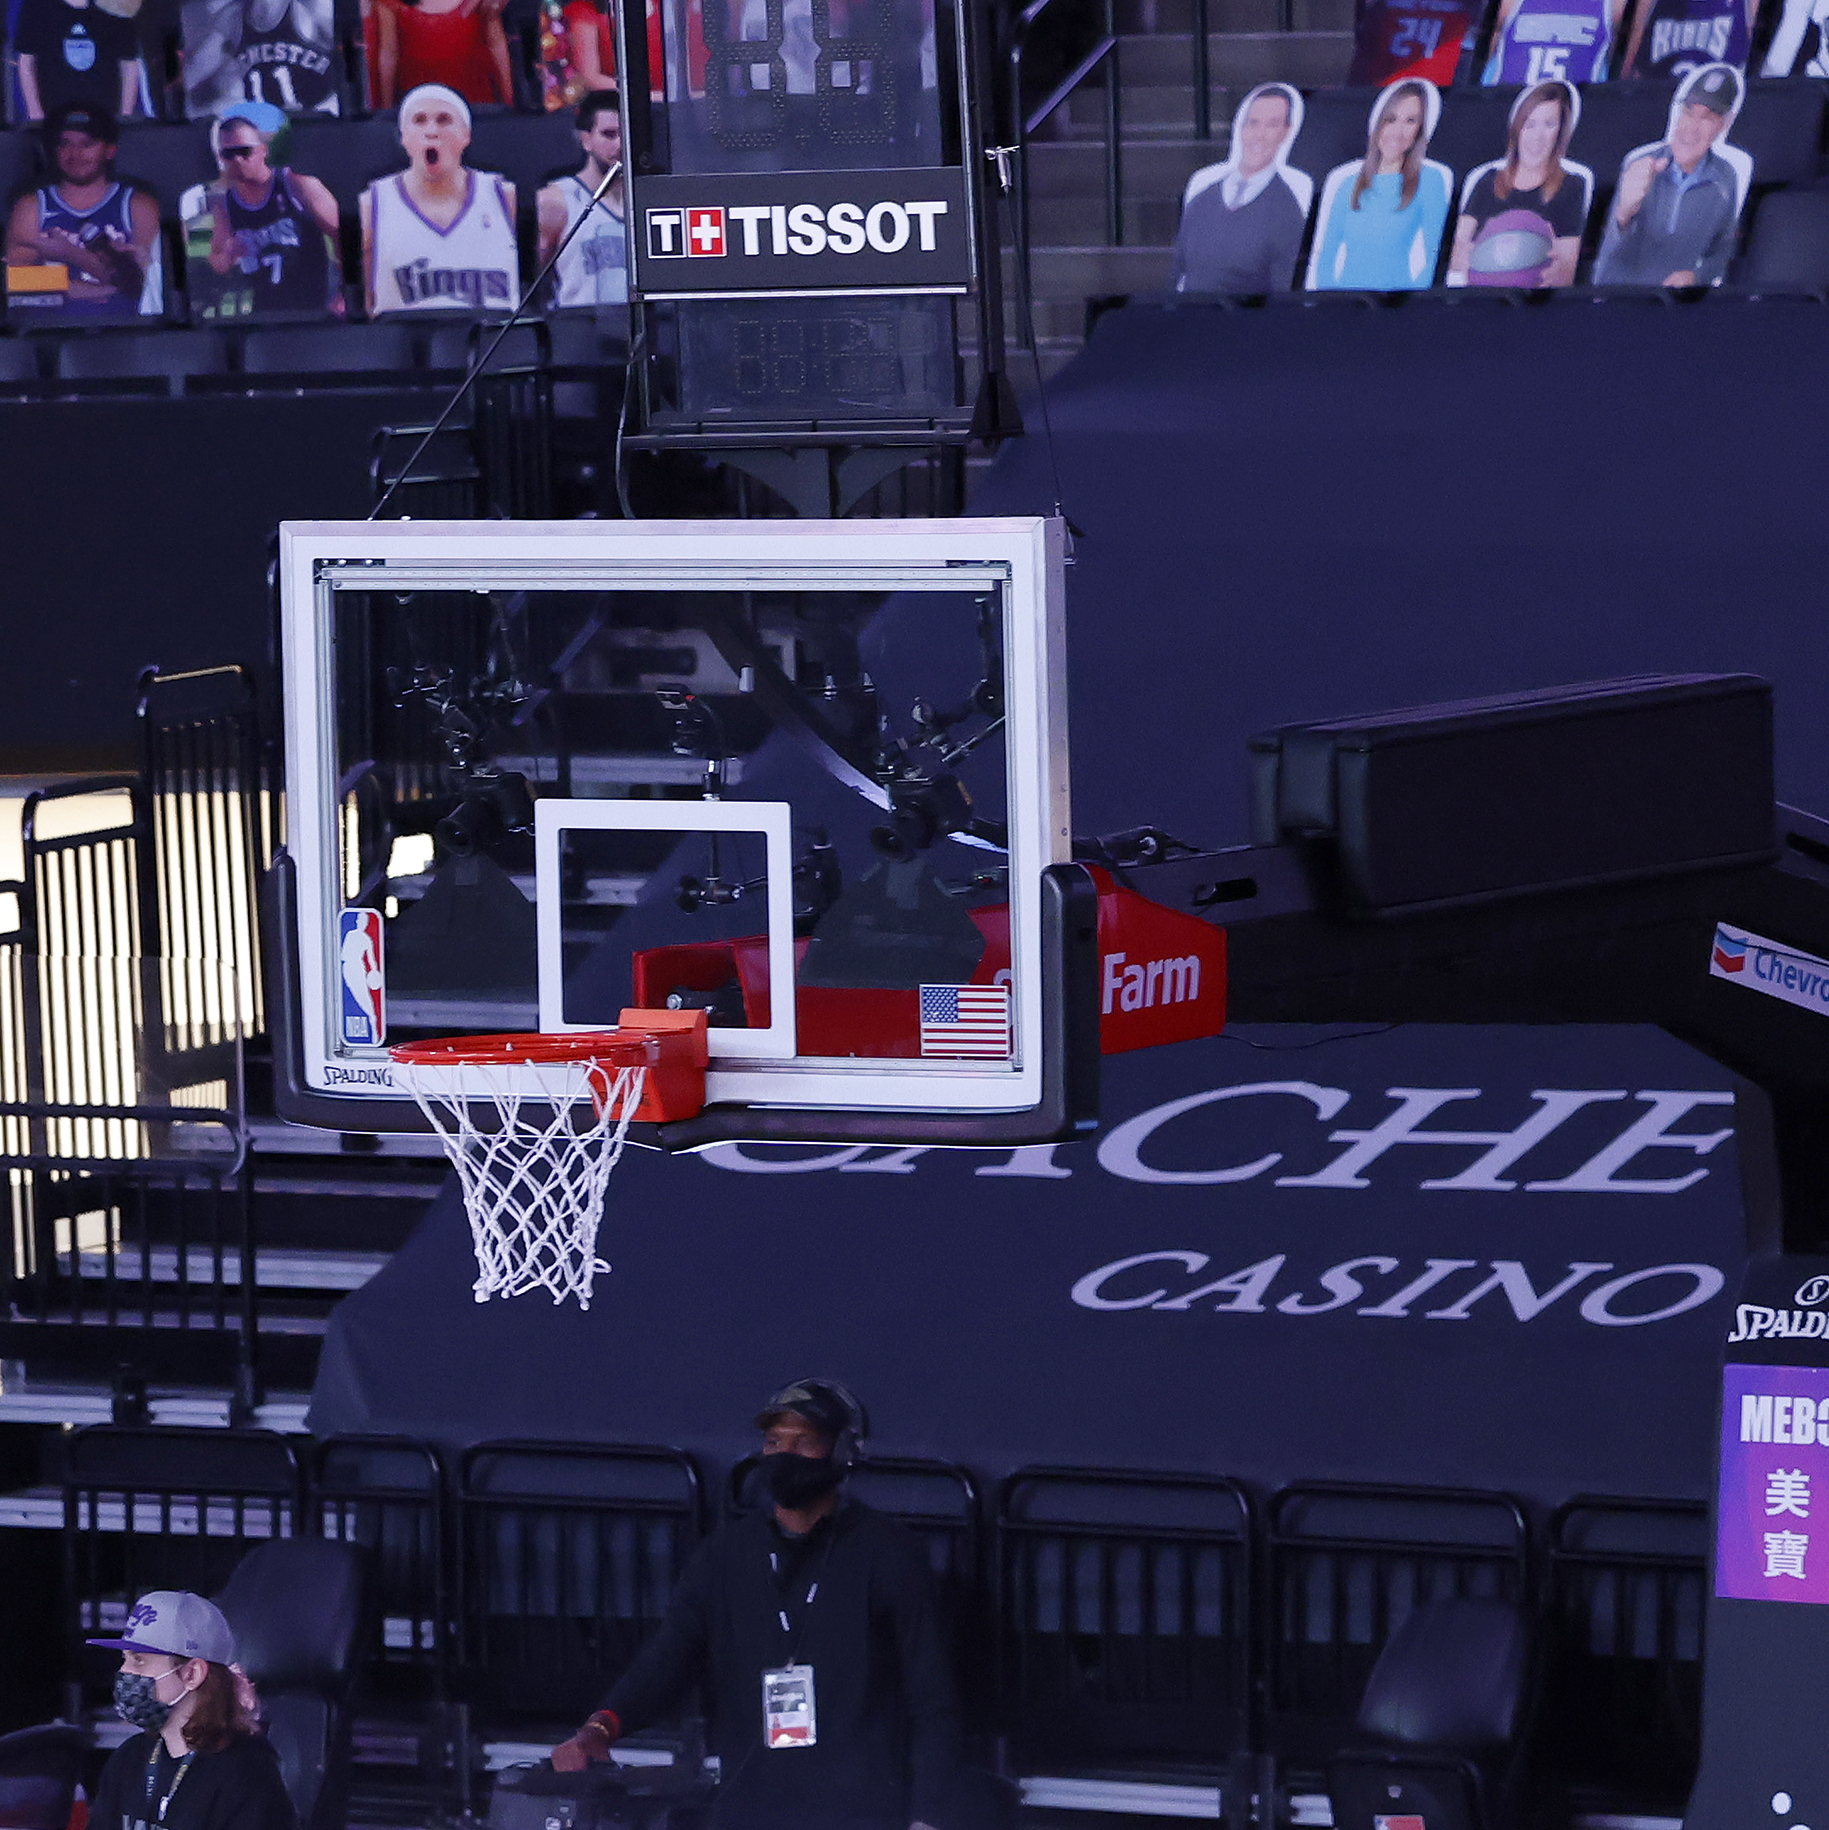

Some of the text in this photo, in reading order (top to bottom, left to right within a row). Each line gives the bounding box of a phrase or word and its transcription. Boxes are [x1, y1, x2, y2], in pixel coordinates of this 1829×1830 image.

[1650, 16, 1734, 63] KINGS
[1526, 46, 1571, 83] 15
[728, 201, 949, 256] TISSOT
[393, 257, 511, 306] Kings
[1101, 954, 1202, 1015] Farm
[323, 1065, 394, 1088] SPALDING
[698, 1080, 1736, 1195] CHE
[1069, 1249, 1726, 1328] CASINO
[1727, 1302, 1829, 1344] SPALD
